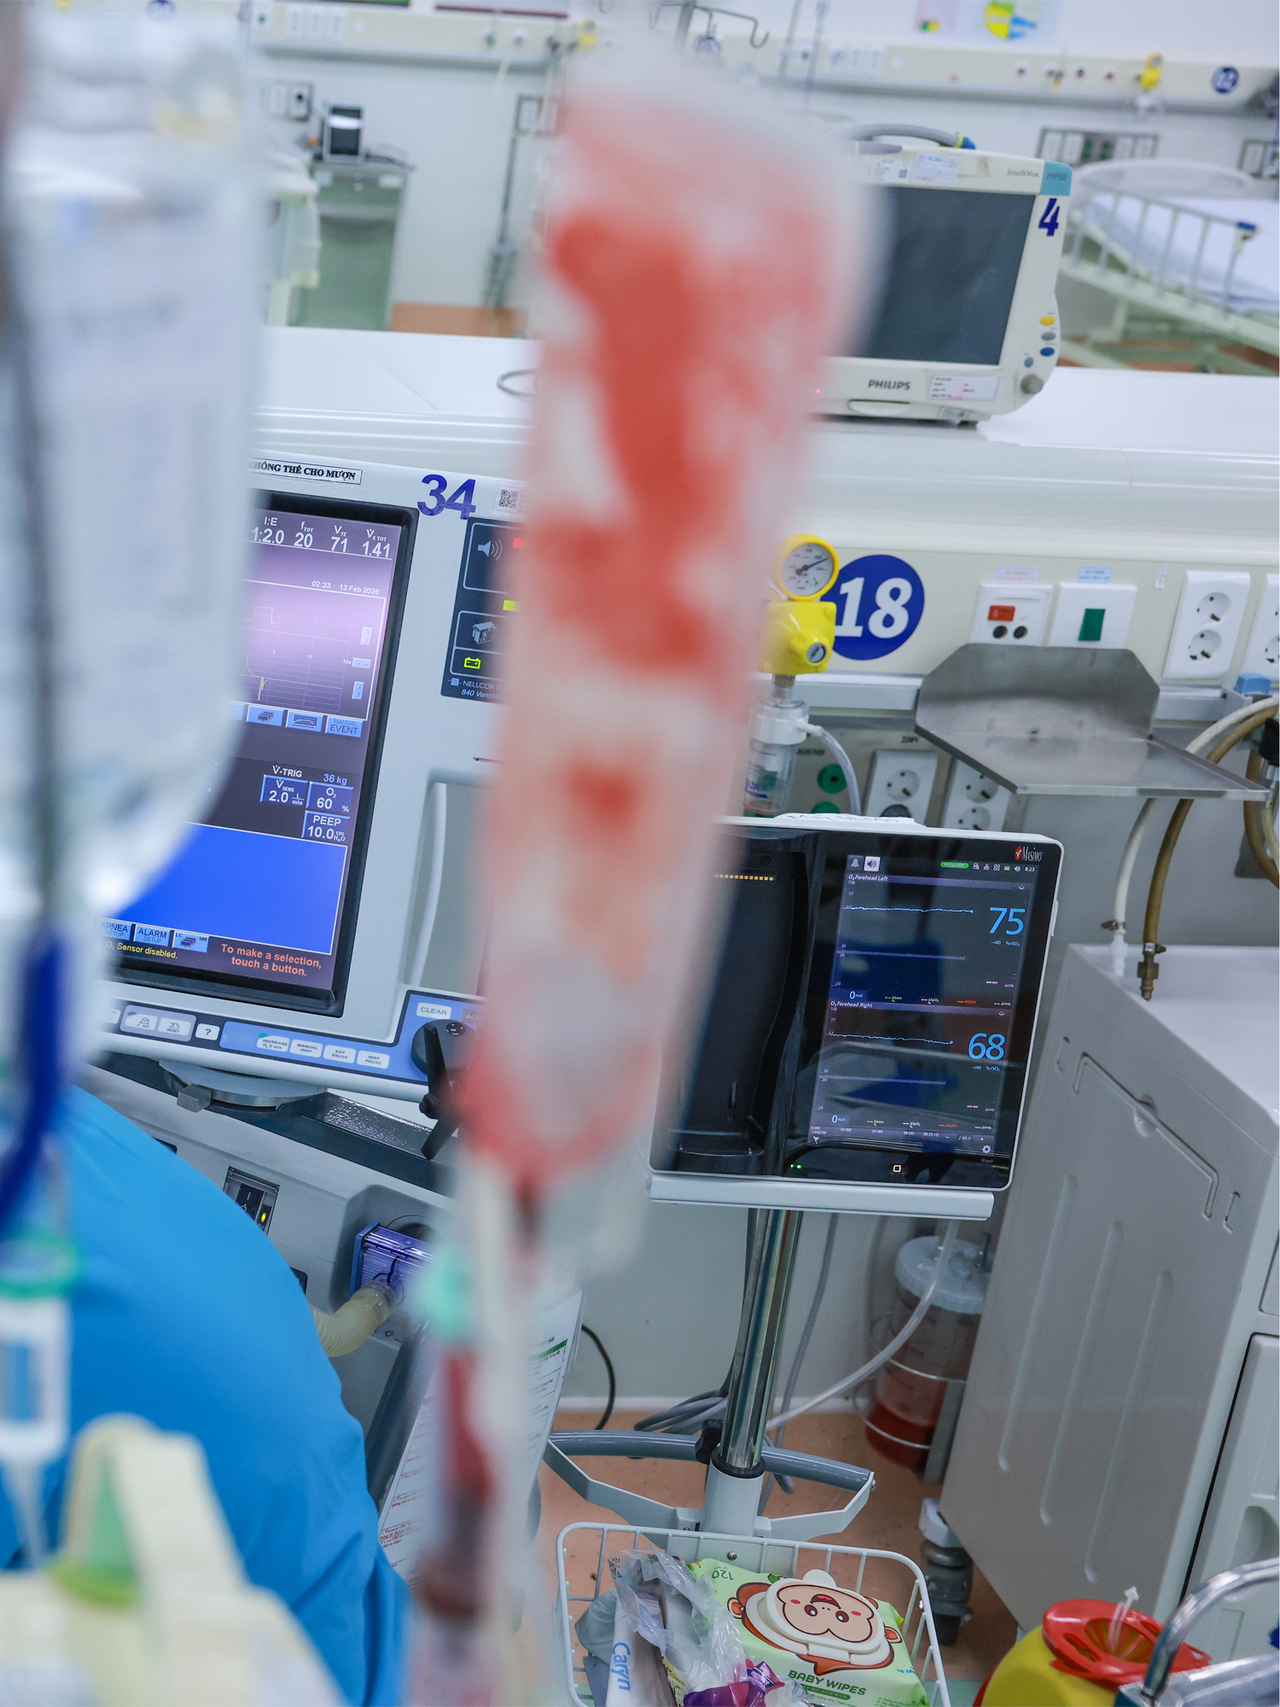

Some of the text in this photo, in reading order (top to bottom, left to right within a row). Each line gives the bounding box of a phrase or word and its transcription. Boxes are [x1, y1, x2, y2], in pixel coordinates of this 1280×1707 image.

[1038, 198, 1060, 237] 4
[867, 379, 911, 391] PHILIPS
[251, 461, 282, 473] HÔNG
[303, 467, 325, 478] CHO
[417, 473, 477, 521] 34
[251, 526, 391, 558] 1:2.0 20 71 1.41
[311, 579, 380, 596] 02:23 13 Feb 2026
[832, 576, 914, 640] 18
[461, 688, 476, 697] 840
[462, 680, 495, 690] NELLCOR
[329, 724, 358, 735] EVENT
[323, 773, 348, 786] 36 kg
[268, 789, 289, 803] 2.0
[316, 797, 333, 810] 60
[312, 814, 342, 827] PEEP
[307, 825, 335, 840] 10.0
[1021, 846, 1043, 862] Masimo
[989, 906, 1026, 936] 75
[137, 927, 168, 939] ALARM
[142, 935, 163, 945] SETUP
[116, 942, 144, 955] Sensor
[144, 946, 178, 960] disabled.
[221, 943, 322, 970] To make a selection,
[231, 956, 308, 977] touch a button.
[420, 1006, 448, 1016] CLEAR
[262, 1038, 288, 1047] INCREASE
[296, 1042, 319, 1051] MANUAL
[968, 1032, 1006, 1061] 68
[365, 1058, 382, 1066] PAUSE
[711, 1569, 734, 1581] 120
[612, 1641, 632, 1693] Caryn
[787, 1669, 867, 1696] BABY WIPES
